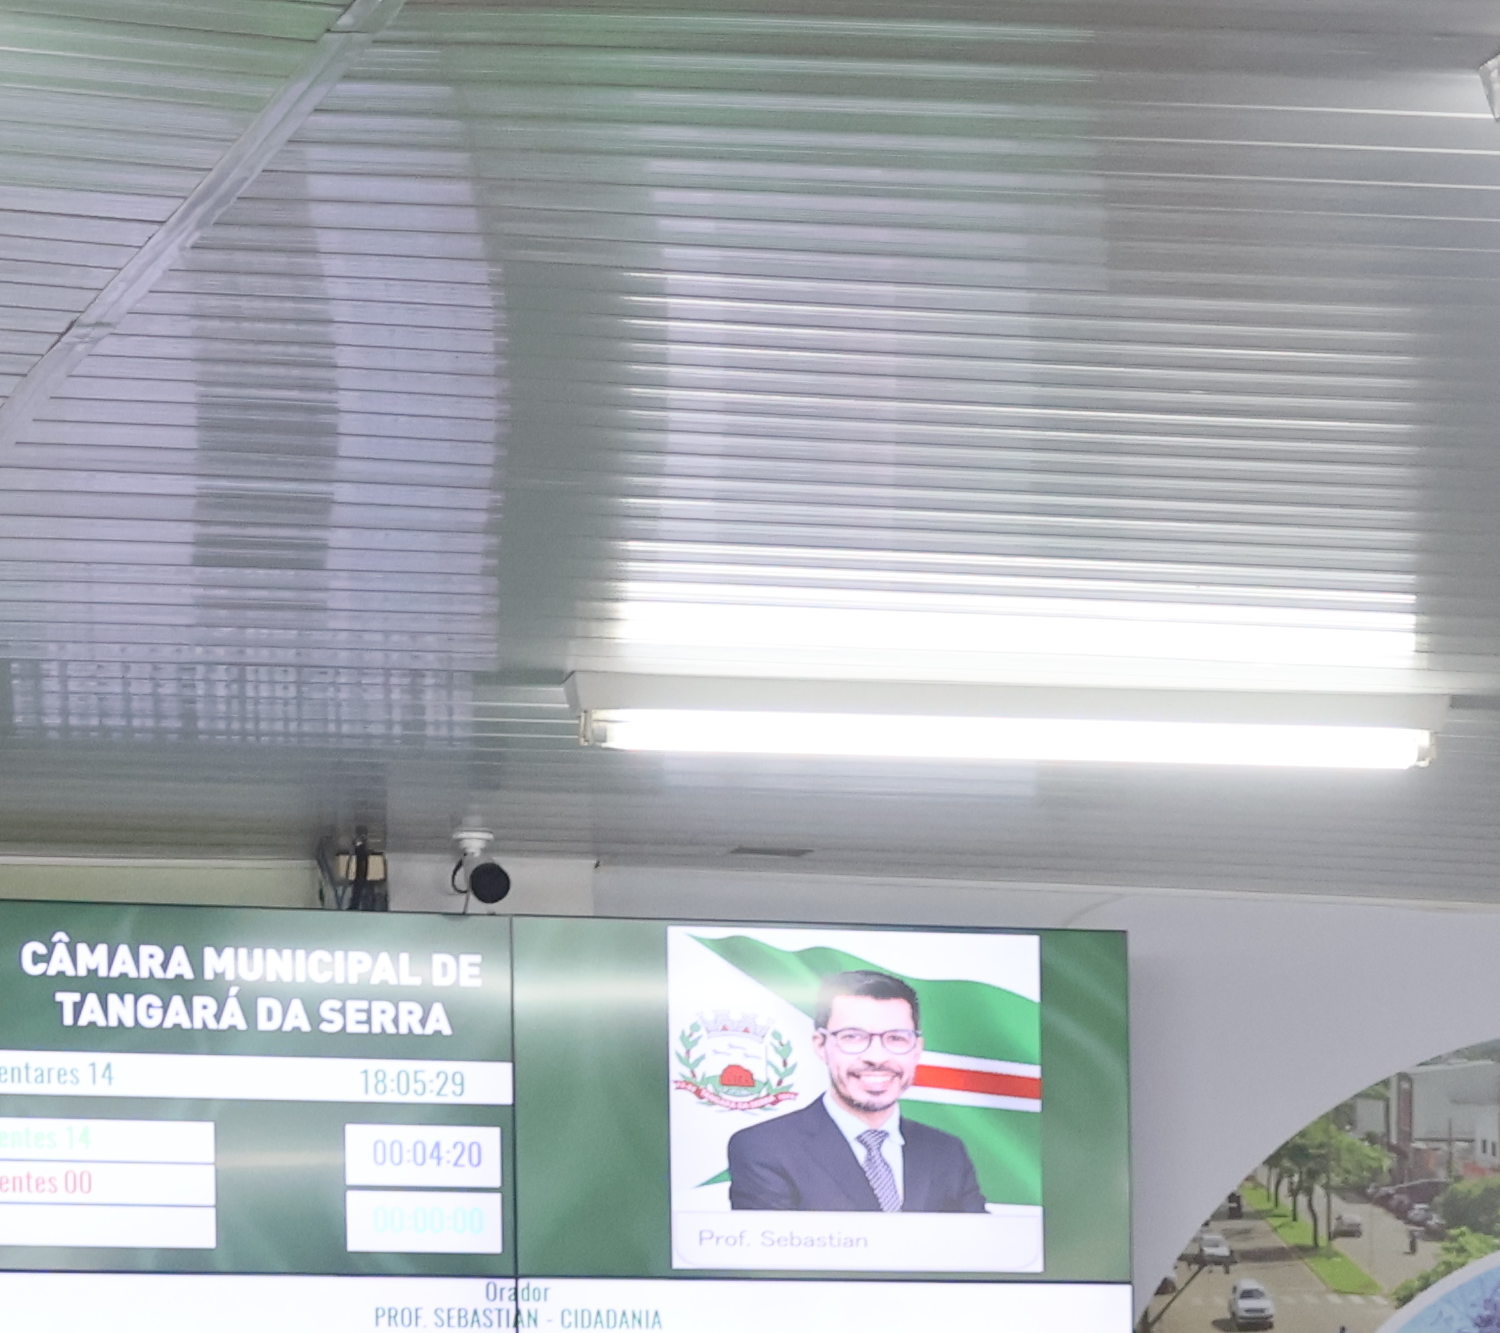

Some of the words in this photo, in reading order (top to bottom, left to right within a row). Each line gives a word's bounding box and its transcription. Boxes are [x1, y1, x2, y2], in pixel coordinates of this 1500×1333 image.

[20, 932, 194, 981] CÂMARA
[203, 946, 421, 986] MUNICIPAL
[432, 954, 482, 987] DE
[55, 987, 247, 1031] TANGARÁ
[257, 996, 311, 1033] DA
[319, 998, 452, 1036] SERRA
[88, 1061, 114, 1087] 14
[359, 1068, 465, 1098] 18:05:29
[65, 1125, 92, 1149] 14
[373, 1139, 482, 1168] 00:04:20
[64, 1169, 93, 1194] 00
[373, 1206, 484, 1235] 00:00:00
[698, 1229, 751, 1248] Prof.
[760, 1230, 868, 1249] Sebastian
[485, 1281, 550, 1302] Orador
[374, 1306, 428, 1329] PROF.
[434, 1307, 539, 1329] SEBASTIAN
[560, 1308, 663, 1330] CIDADANIA
